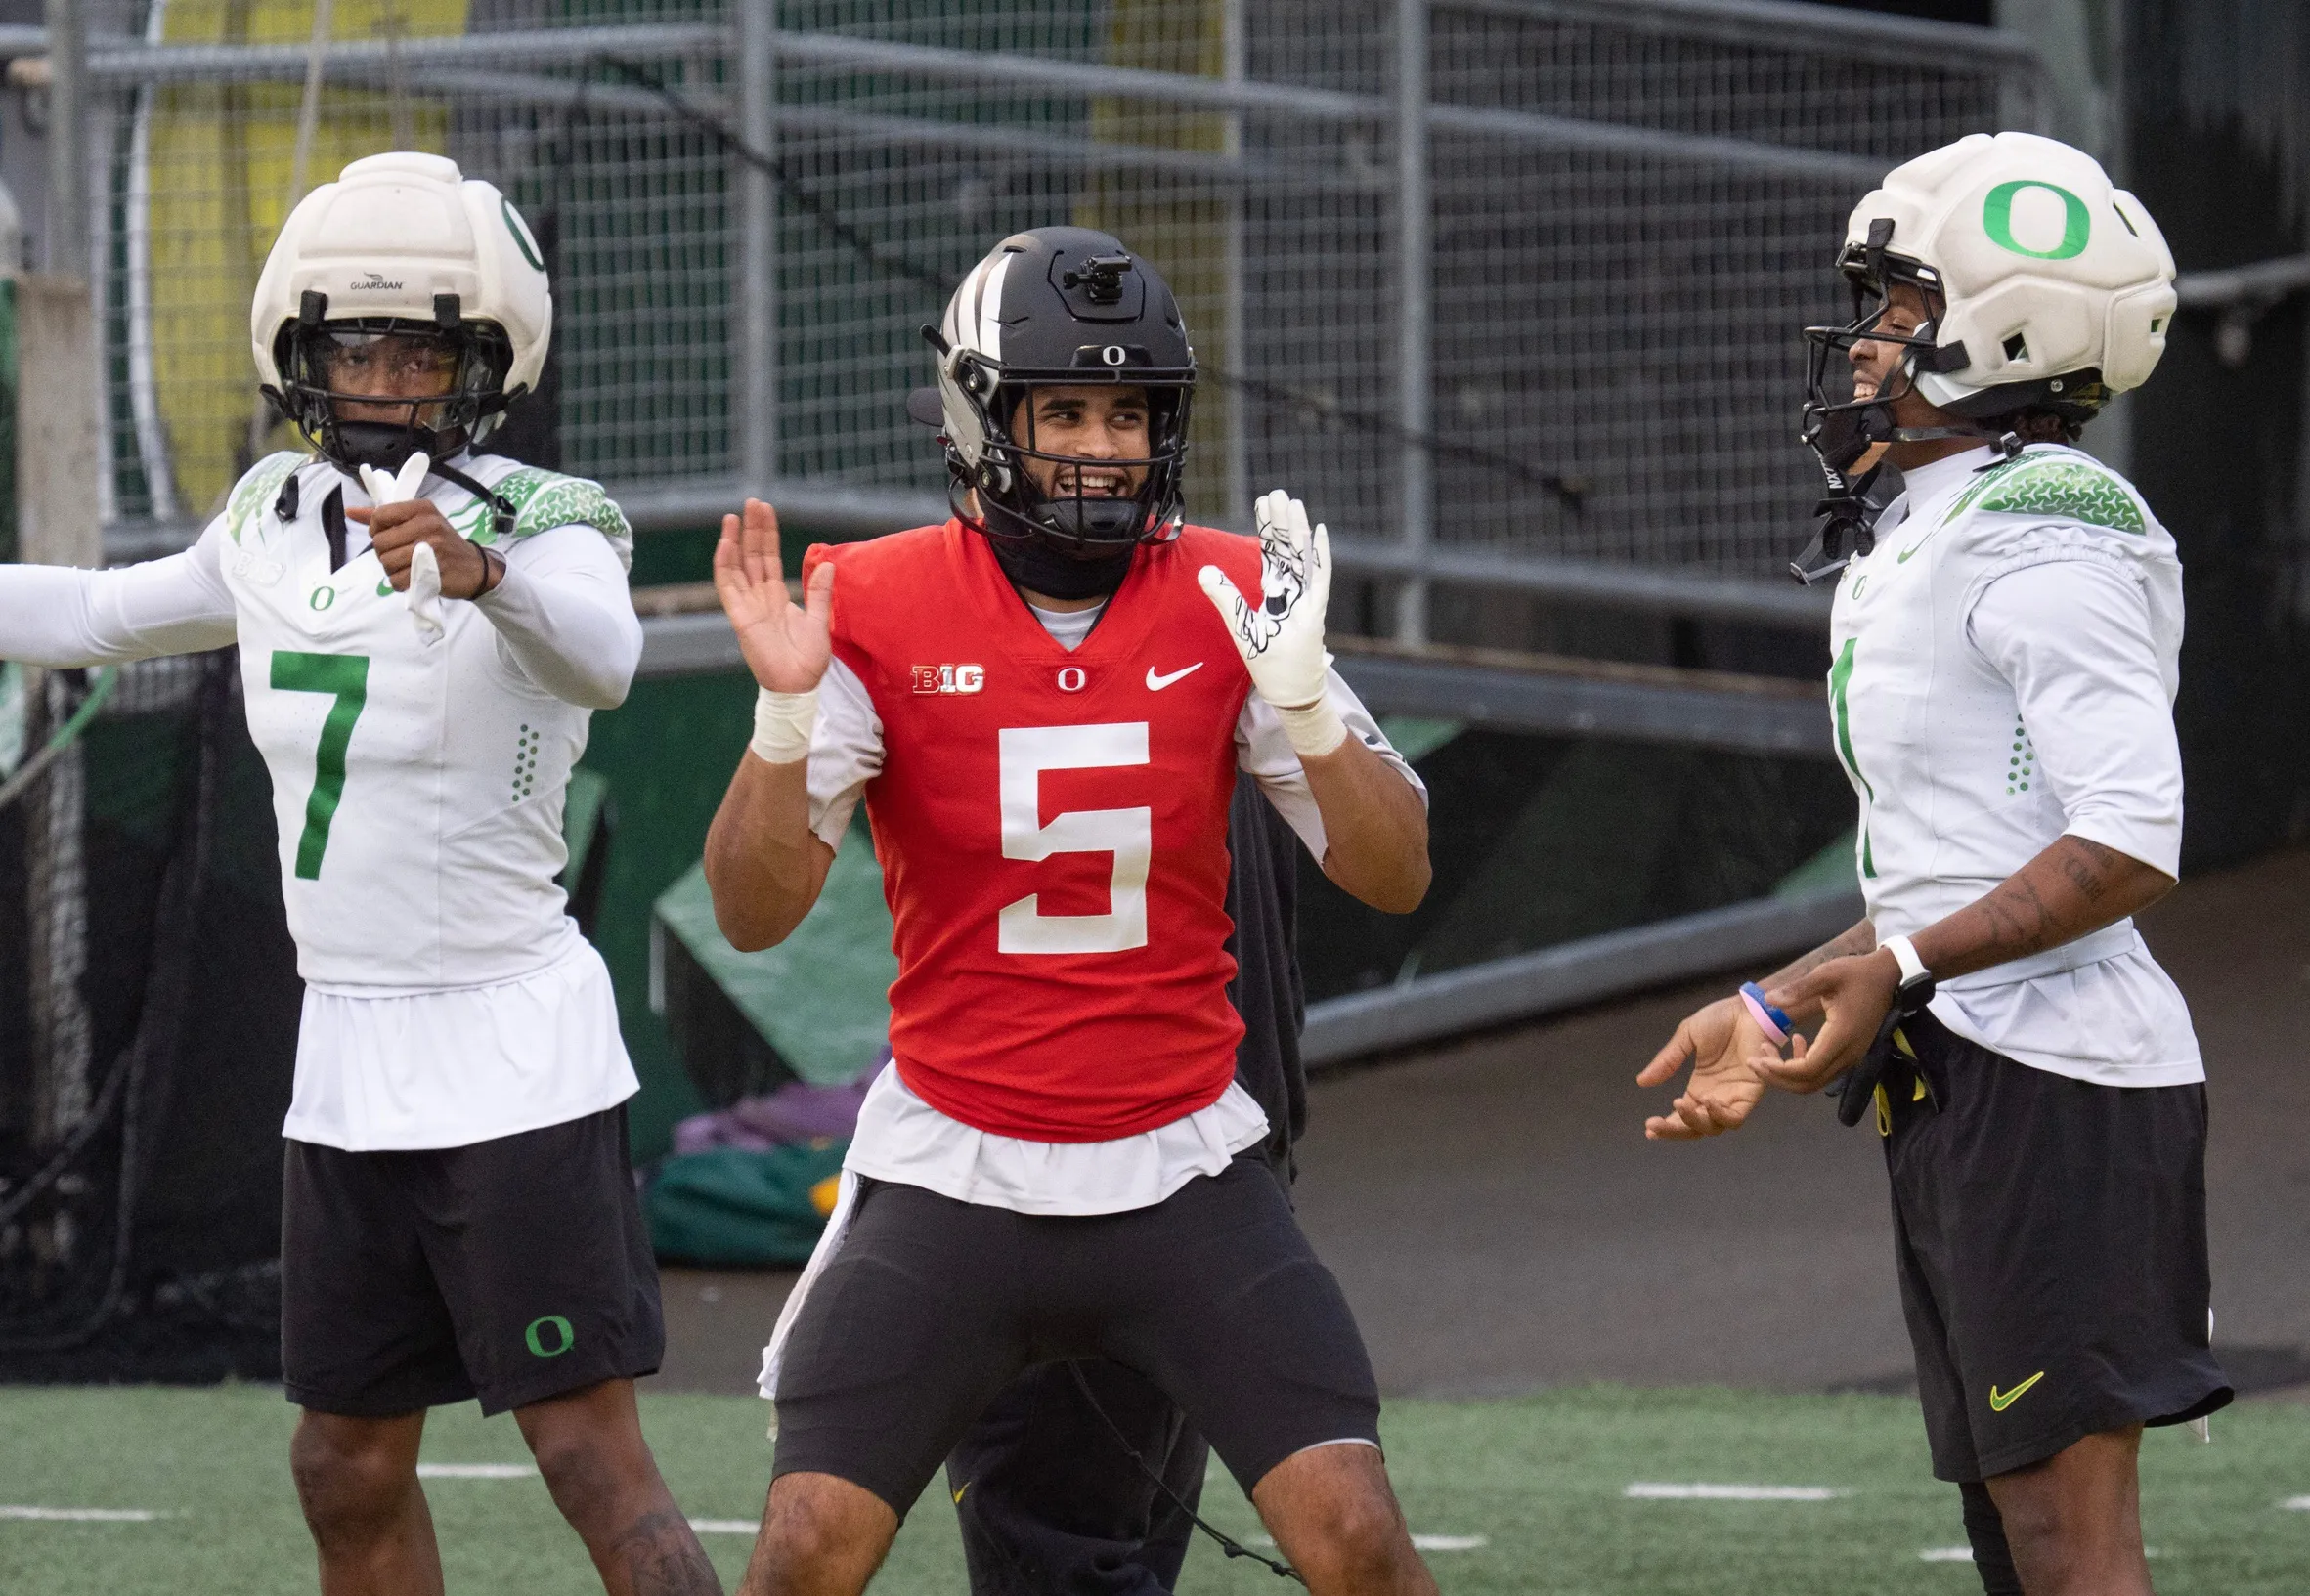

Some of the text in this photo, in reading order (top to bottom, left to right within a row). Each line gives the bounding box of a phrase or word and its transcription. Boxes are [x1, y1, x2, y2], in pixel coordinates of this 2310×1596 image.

[1983, 179, 2091, 261] O
[350, 281, 403, 290] GUARDIAN
[1102, 345, 1126, 366] O
[309, 586, 335, 611] O
[1057, 667, 1086, 692] O
[270, 650, 370, 881] 7
[998, 721, 1152, 955] 5
[525, 1316, 574, 1358] O
